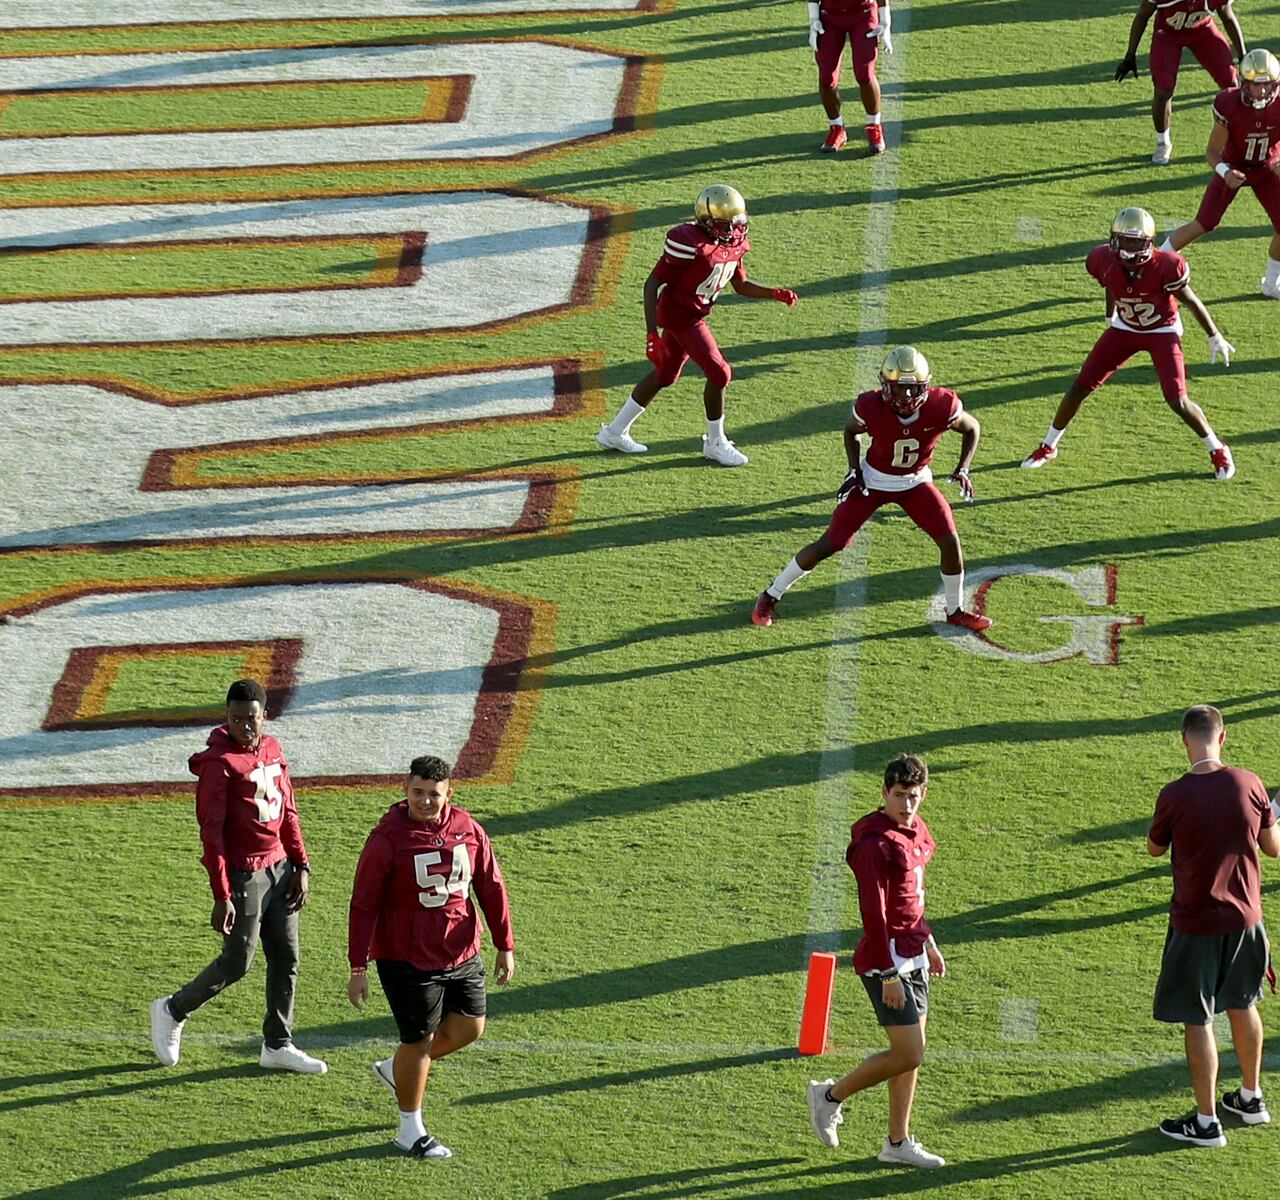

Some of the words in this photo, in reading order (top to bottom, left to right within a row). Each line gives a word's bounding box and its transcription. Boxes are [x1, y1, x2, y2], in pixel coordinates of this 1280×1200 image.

[1244, 136, 1271, 162] 11
[891, 438, 921, 468] 6
[926, 562, 1145, 667] G
[413, 842, 472, 909] 54
